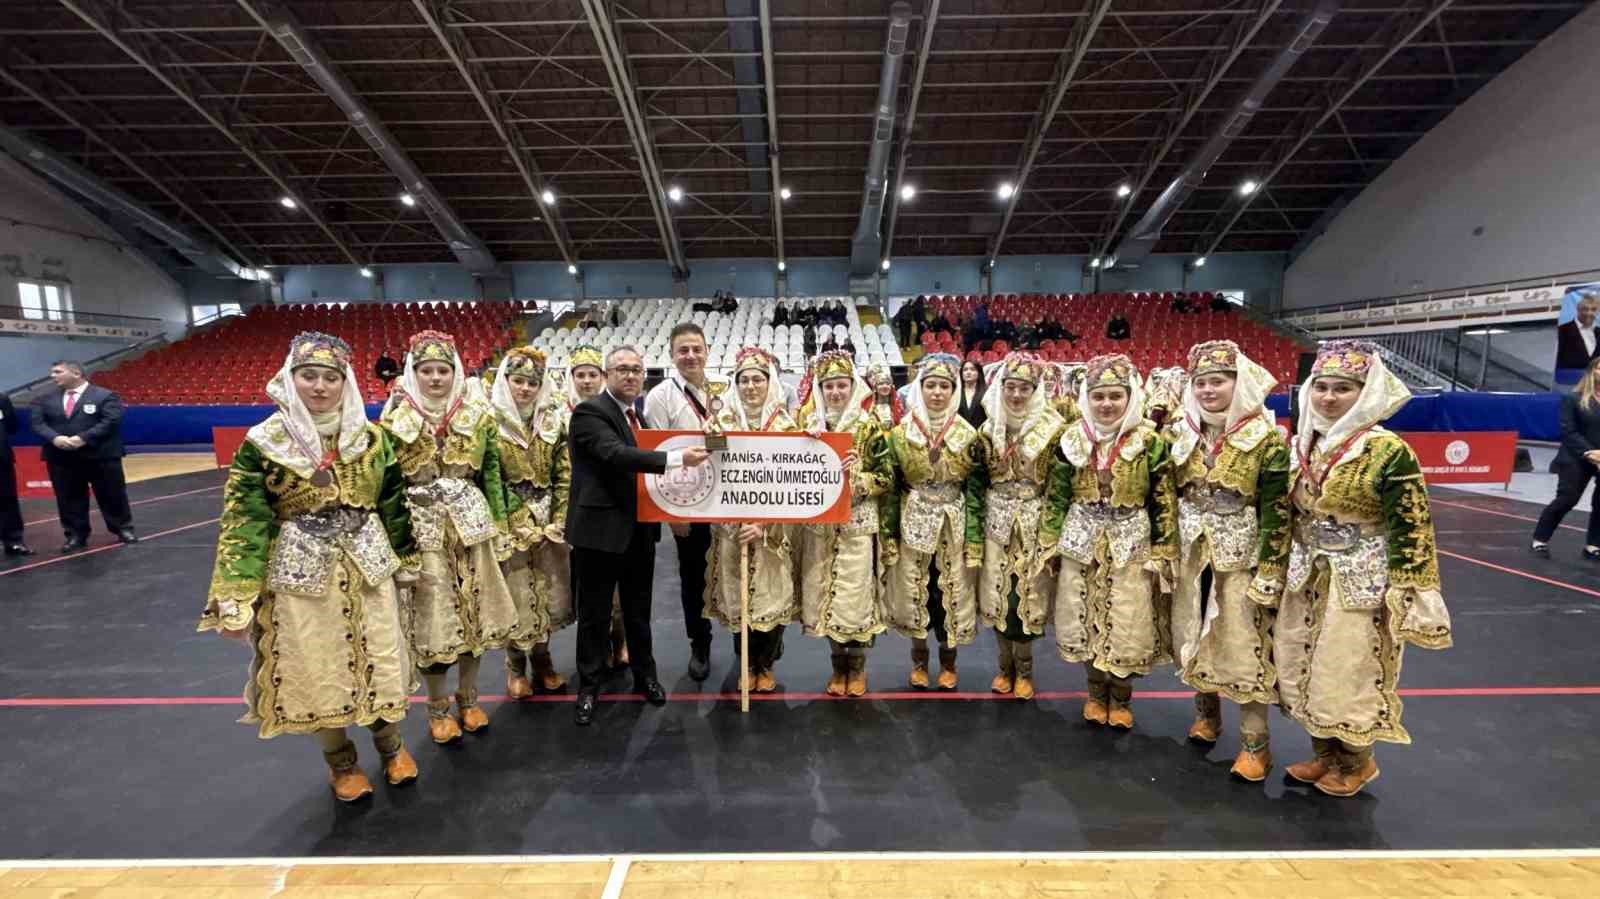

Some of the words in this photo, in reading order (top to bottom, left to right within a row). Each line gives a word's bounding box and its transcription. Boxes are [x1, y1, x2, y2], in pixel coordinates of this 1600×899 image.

[721, 451, 763, 463] MANİSA
[772, 452, 826, 466] KIRKAĞAÇ
[721, 467, 773, 483] ECZ.ENGİN
[776, 467, 840, 484] ÜMMETOĞLU
[721, 490, 784, 505] ANADOLU
[787, 488, 824, 505] LİSESİ
